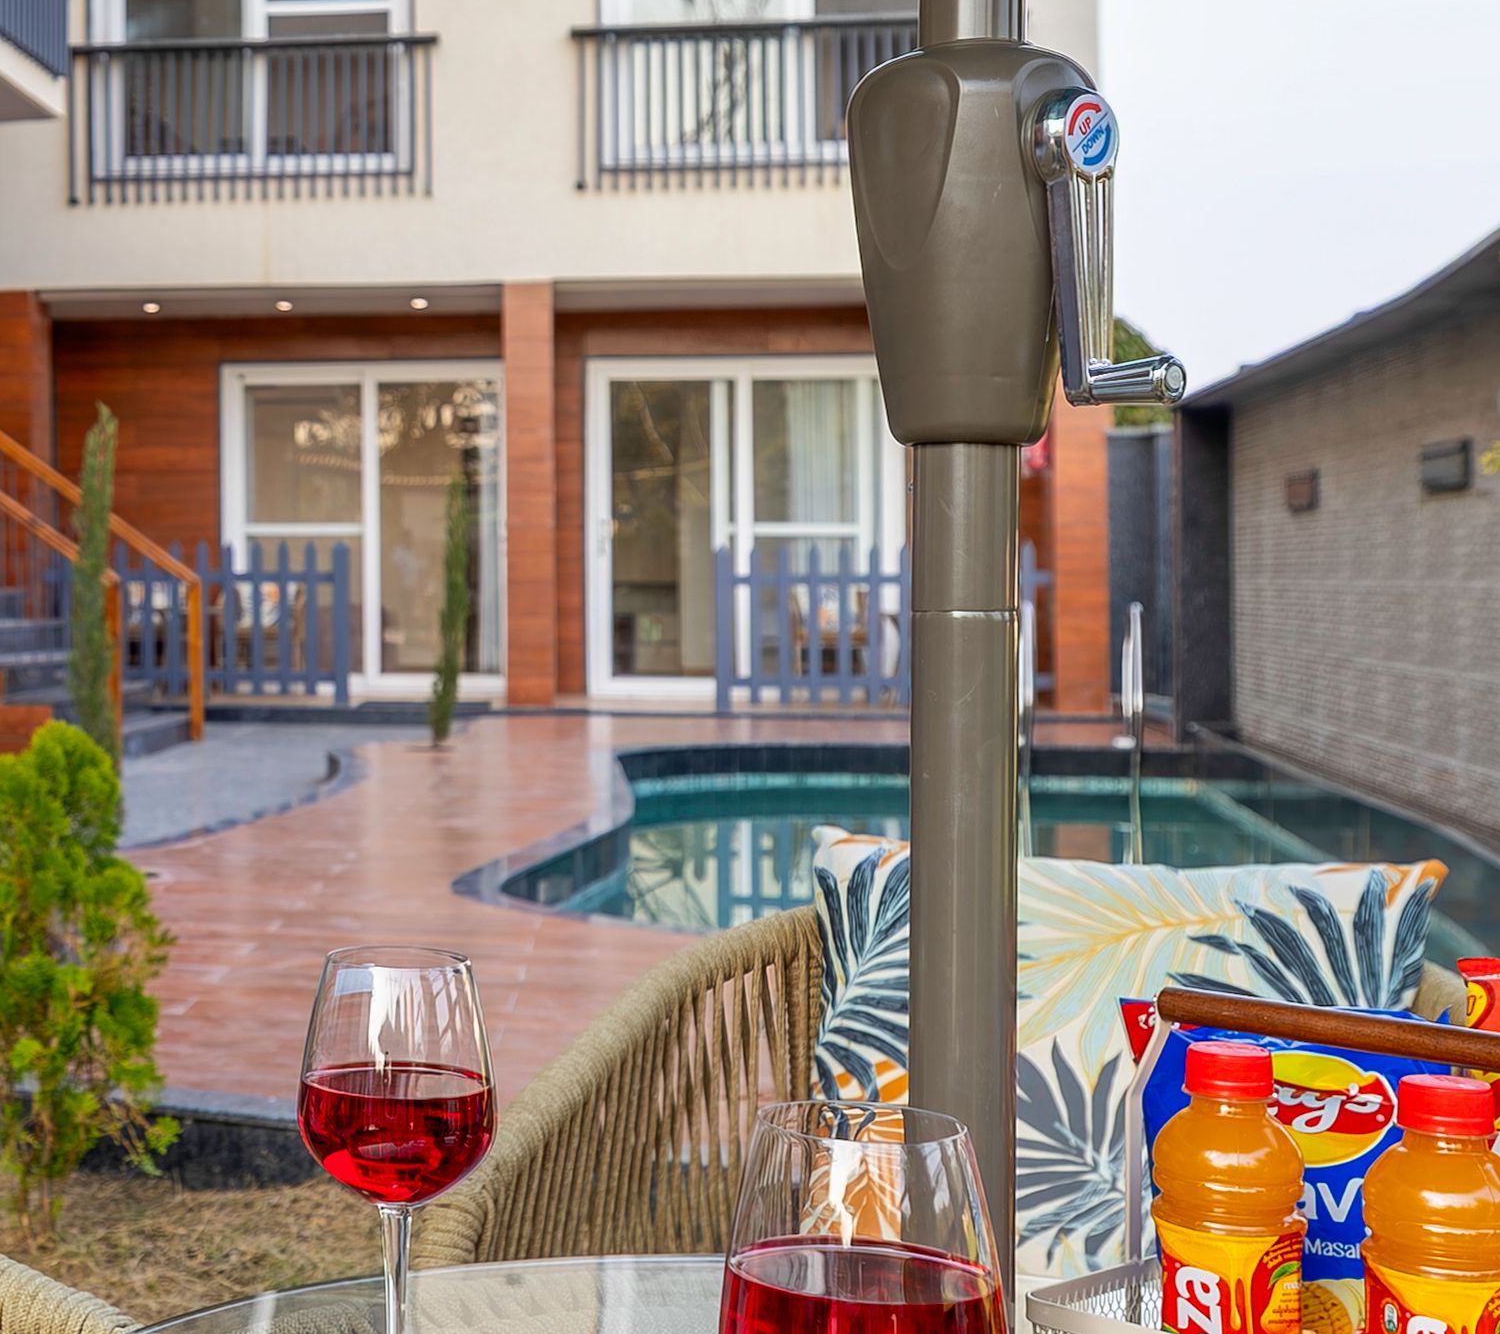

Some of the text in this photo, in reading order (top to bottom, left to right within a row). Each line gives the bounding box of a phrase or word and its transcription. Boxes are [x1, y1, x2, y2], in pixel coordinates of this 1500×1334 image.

[1079, 117, 1091, 135] UP
[1081, 125, 1105, 155] DOWN
[1304, 1236, 1361, 1260] Masal
